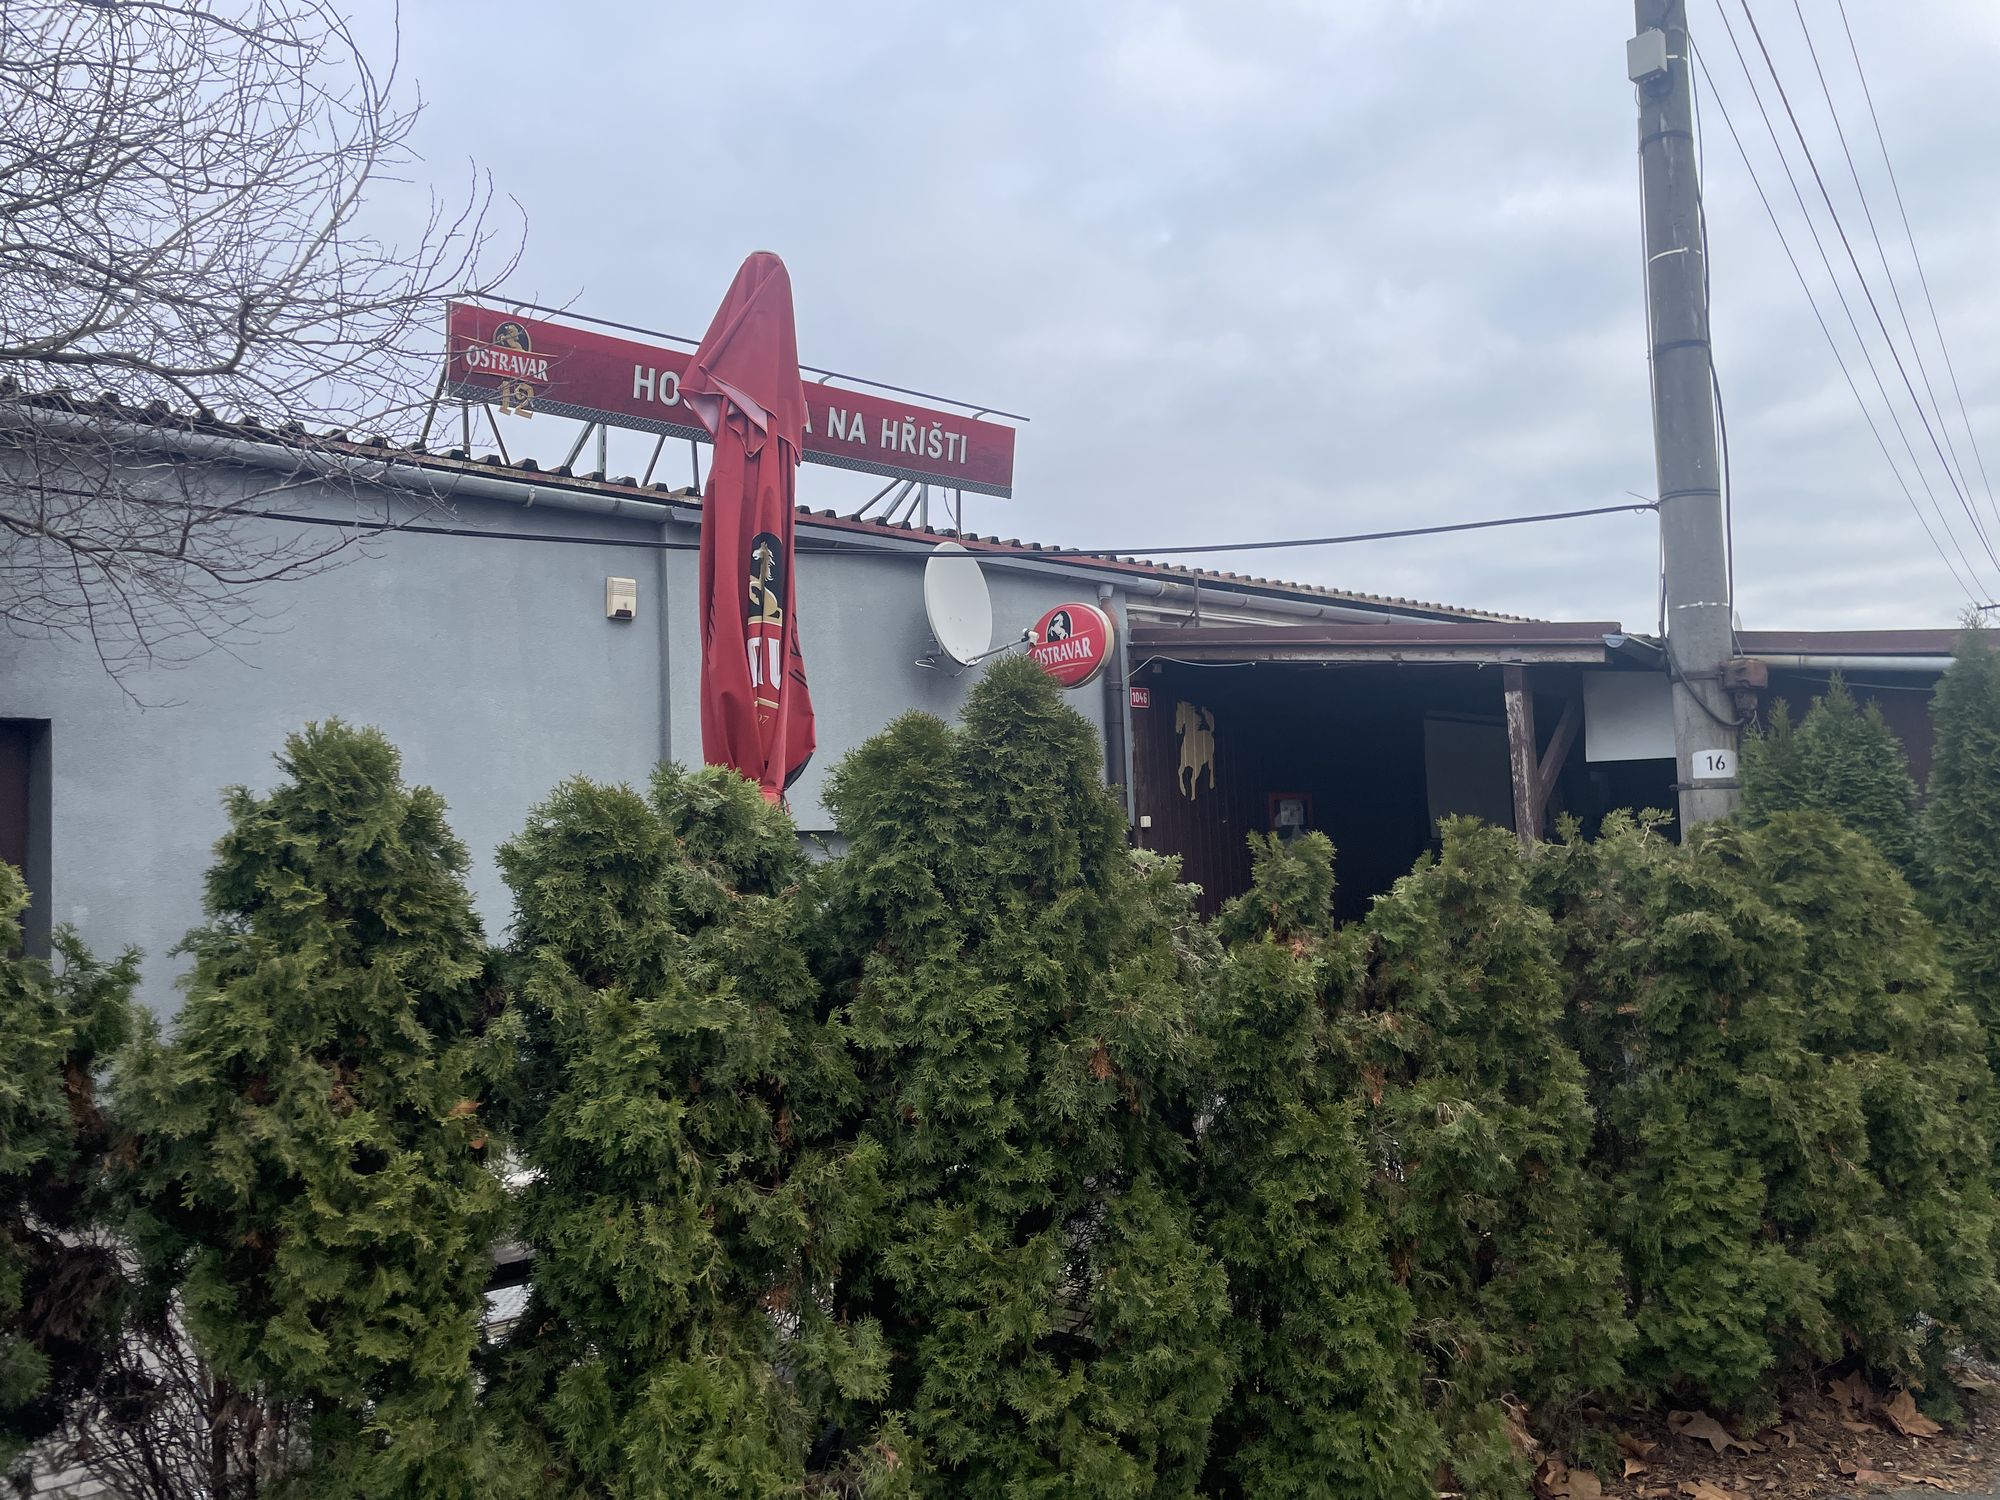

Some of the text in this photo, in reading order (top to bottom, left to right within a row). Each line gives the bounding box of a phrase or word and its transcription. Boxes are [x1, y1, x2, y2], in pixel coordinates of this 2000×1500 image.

[465, 345, 549, 382] OSTRAVAR
[498, 379, 535, 420] 12
[827, 406, 867, 445] NA
[880, 415, 968, 465] HŘIŠTI
[1034, 637, 1093, 667] OSTRAVAR
[1132, 691, 1148, 704] 1046
[1706, 755, 1726, 771] 16
